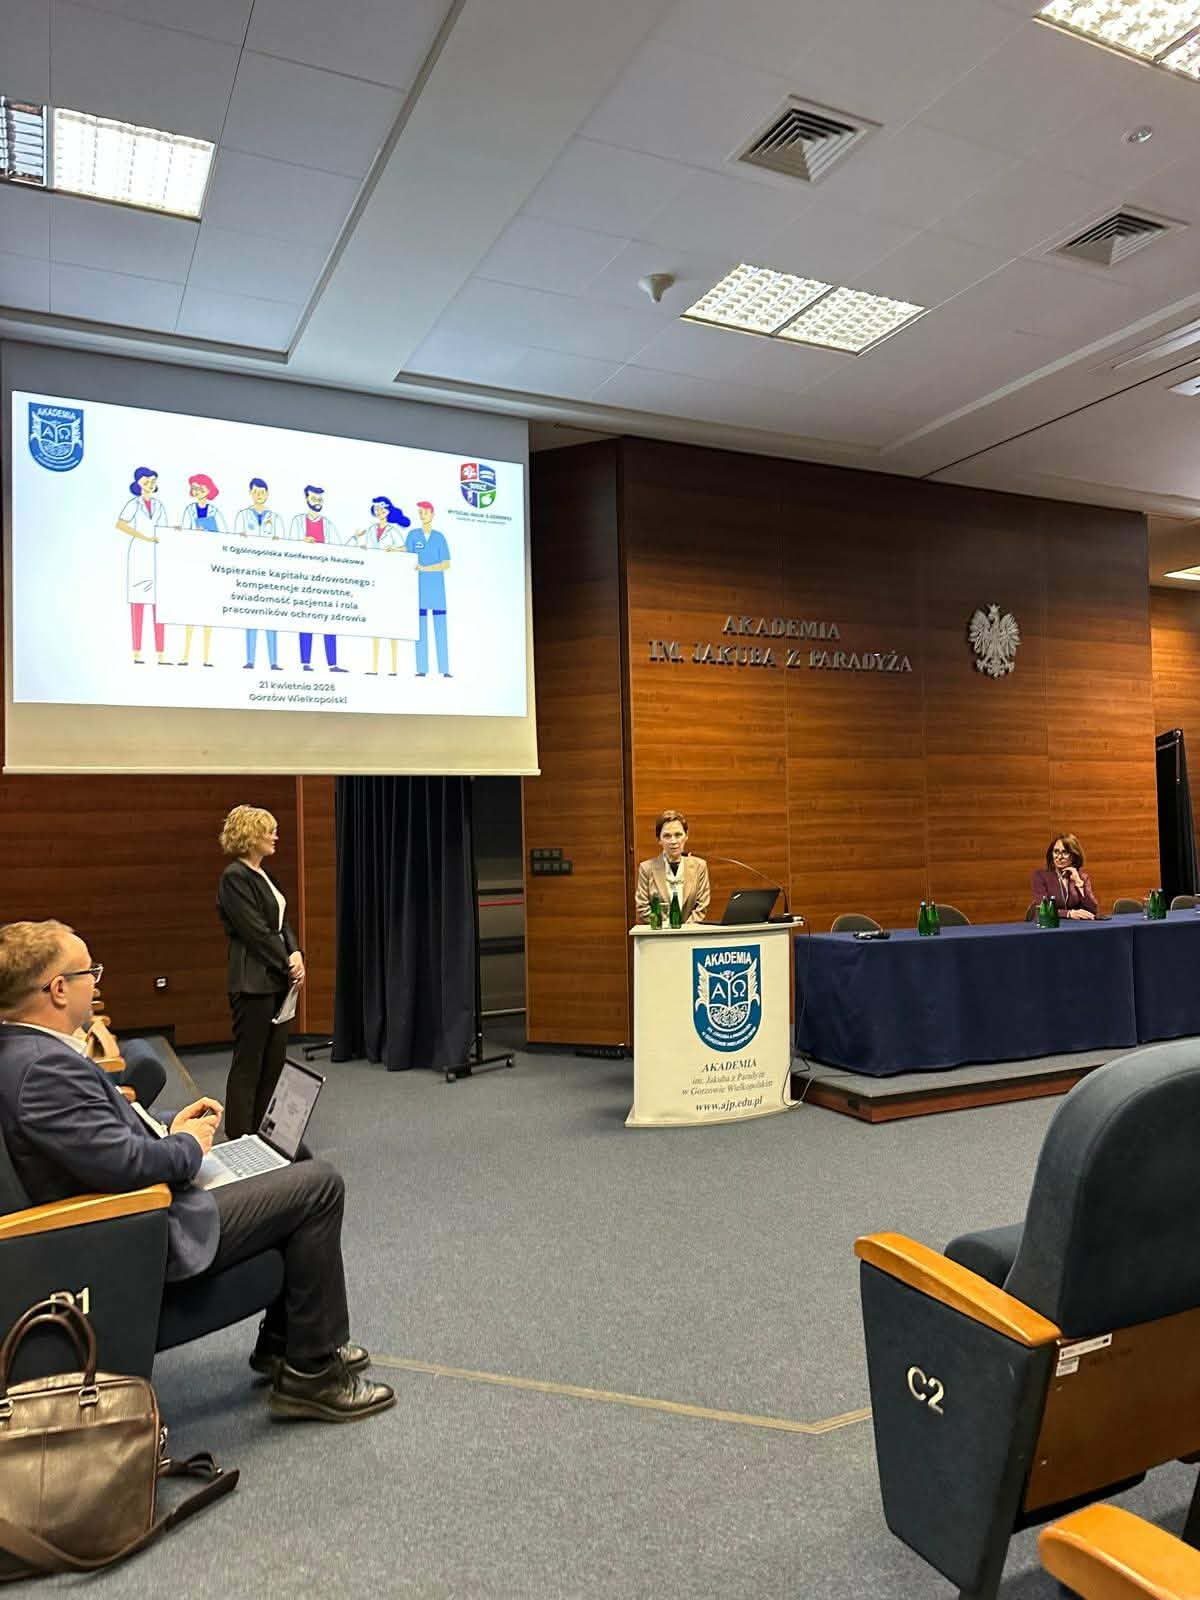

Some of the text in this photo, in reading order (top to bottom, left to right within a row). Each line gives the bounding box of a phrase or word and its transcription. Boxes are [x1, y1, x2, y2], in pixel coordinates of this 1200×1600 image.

[229, 546, 283, 558] Ogólnopolska
[284, 552, 329, 563] Konferencja
[330, 555, 365, 566] Naukowa
[211, 564, 267, 578] Wspieranie
[269, 569, 309, 581] kapitału
[311, 574, 370, 588] zdrowotnego
[236, 579, 353, 598] kompetencje zdrowotne,
[231, 592, 291, 605] świadomość
[293, 598, 333, 612] pacjenta
[340, 600, 359, 610] rola
[222, 605, 367, 623] pracowników ochrony zdrowia
[722, 615, 840, 640] AKADEMIA
[649, 639, 913, 672] IM. JAKUBA Z PARADYŻA
[259, 680, 269, 689] 21
[270, 681, 312, 691] kwietnia
[249, 693, 348, 705] Gorzów Wielkopolski
[704, 951, 752, 968] AKADEMIA
[702, 1058, 757, 1073] AKADEMIA
[706, 1074, 730, 1085] Jakuba
[690, 1086, 725, 1096] Gorzowie
[696, 1096, 763, 1112] www.ajp.edu.pl
[907, 1366, 944, 1416] C2
